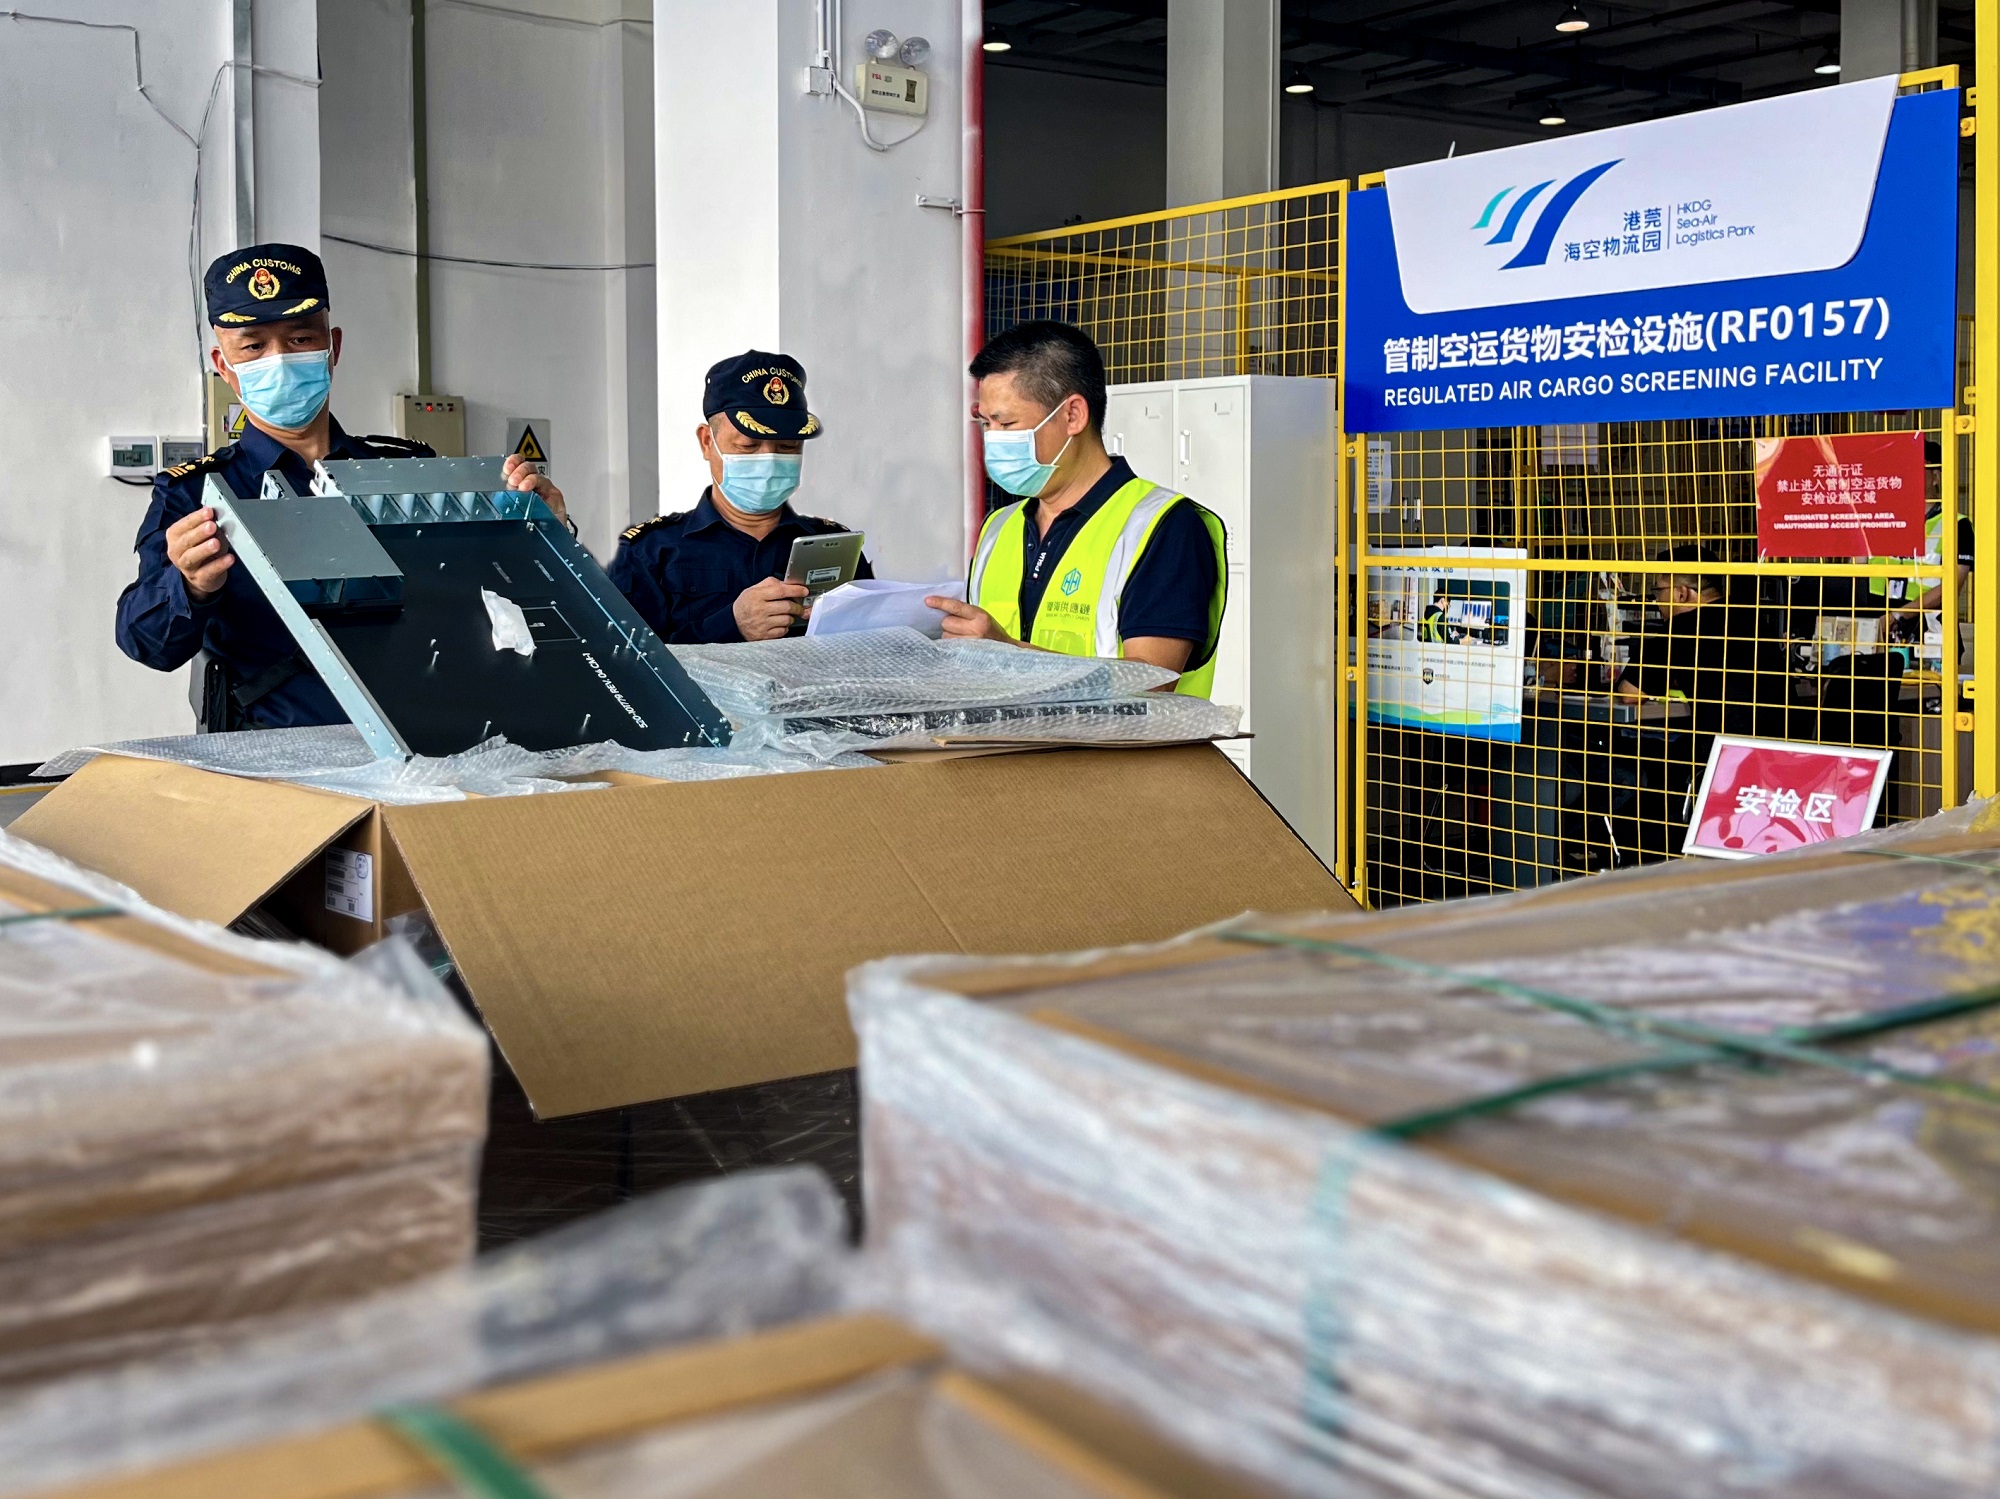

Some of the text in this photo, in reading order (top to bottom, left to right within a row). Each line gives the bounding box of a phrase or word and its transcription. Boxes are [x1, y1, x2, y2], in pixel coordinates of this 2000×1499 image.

[1676, 199, 1712, 215] HKDG
[1623, 207, 1662, 232] 港莞
[1676, 213, 1718, 229] Sea-Air
[1676, 225, 1756, 246] Logistics Park
[1564, 230, 1661, 262] 海空物流园
[226, 258, 302, 284] CHINA CUSTOMS
[1383, 297, 1890, 374] 管制空运货物安检设施(RF0157)
[741, 368, 768, 384] CHINA
[1384, 357, 1883, 406] REGULATED AIR CARGO SCREENING FACILITY
[1813, 463, 1864, 478] 无通行证
[1776, 476, 1903, 493] 禁止进入管制空运货物
[1801, 490, 1877, 506] 安检设施区域
[1830, 512, 1873, 520] SCREENING
[1830, 521, 1859, 529] ACCESS
[1861, 521, 1907, 529] PROHIBITED
[602, 678, 619, 694] REV.
[1734, 784, 1838, 825] 安检区
